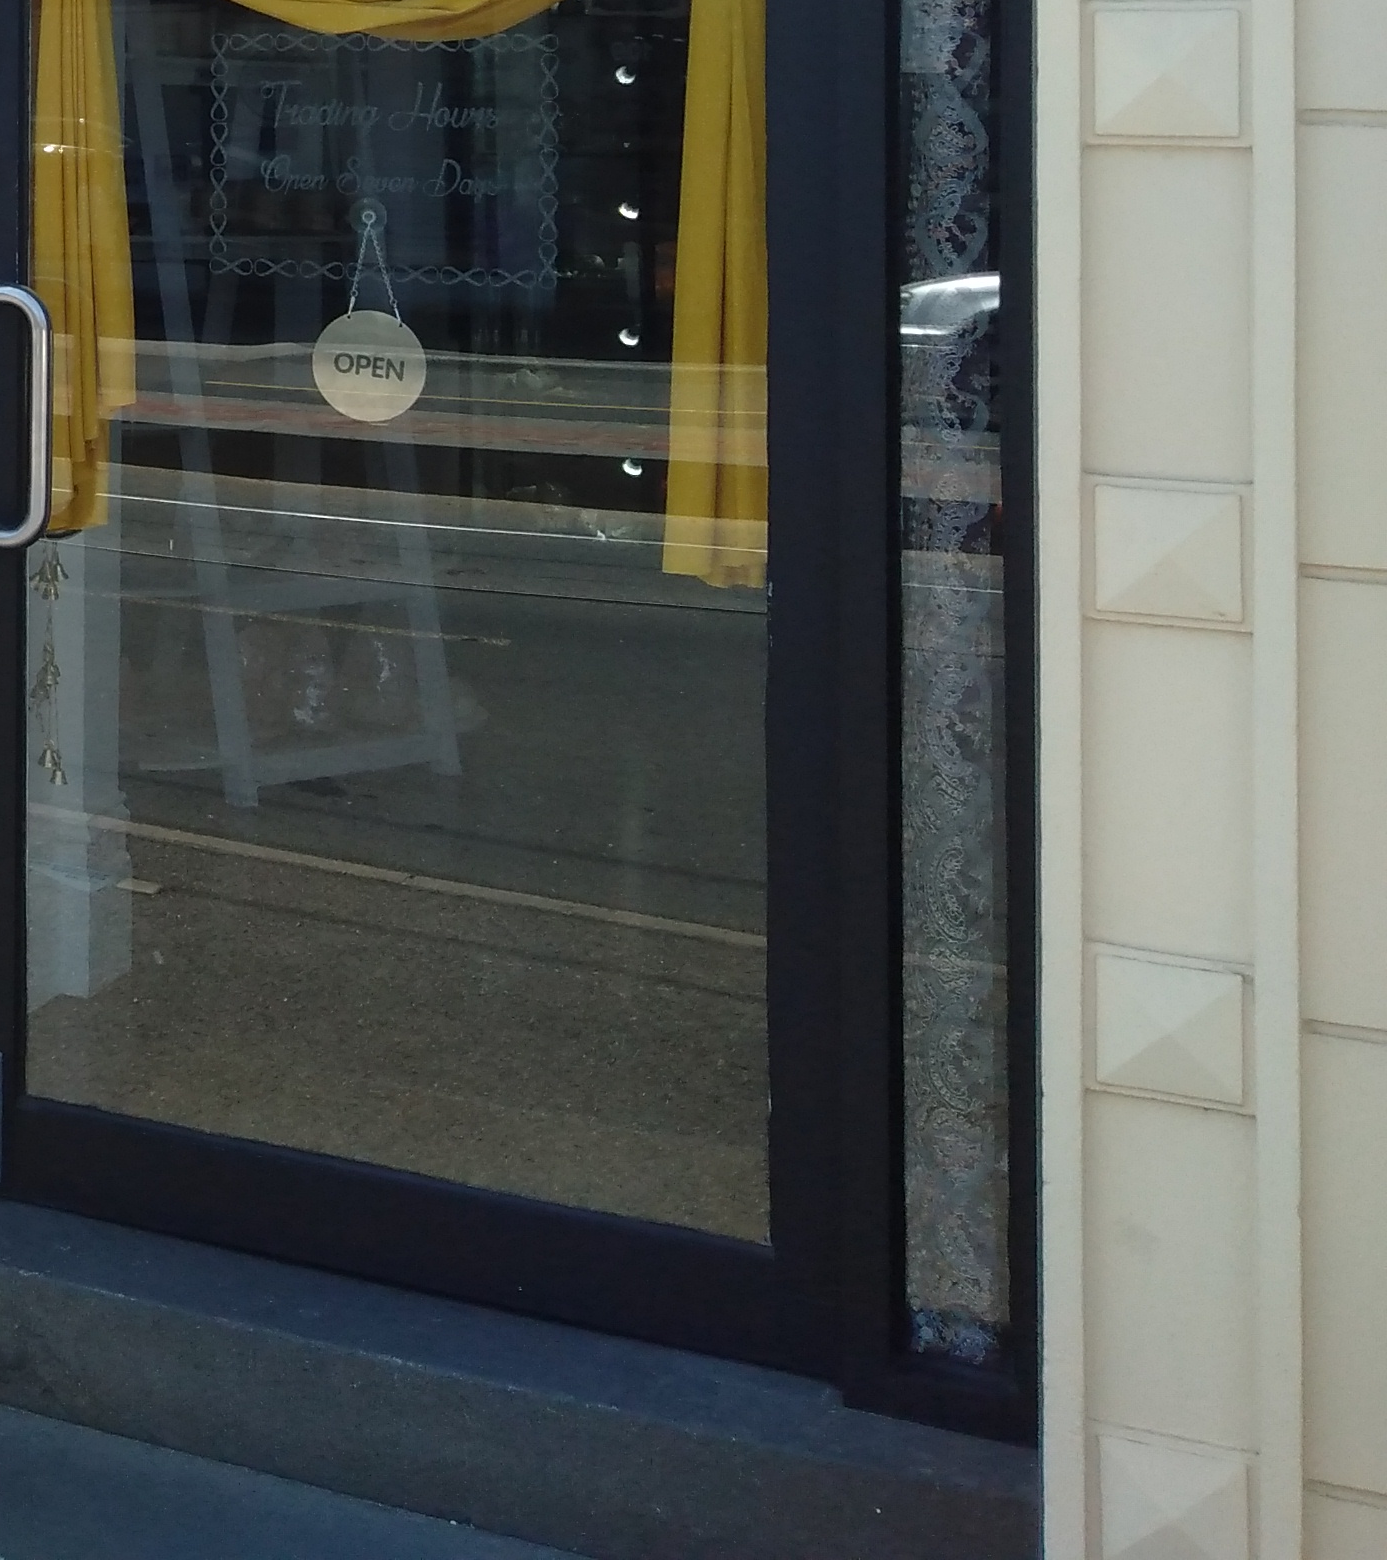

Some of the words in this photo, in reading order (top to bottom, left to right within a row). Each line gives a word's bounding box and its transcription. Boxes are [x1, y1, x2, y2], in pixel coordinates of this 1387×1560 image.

[260, 79, 380, 136] Trading
[387, 81, 500, 131] Hours
[260, 154, 327, 195] Open
[423, 158, 502, 203] Days
[333, 352, 405, 382] OPEN
